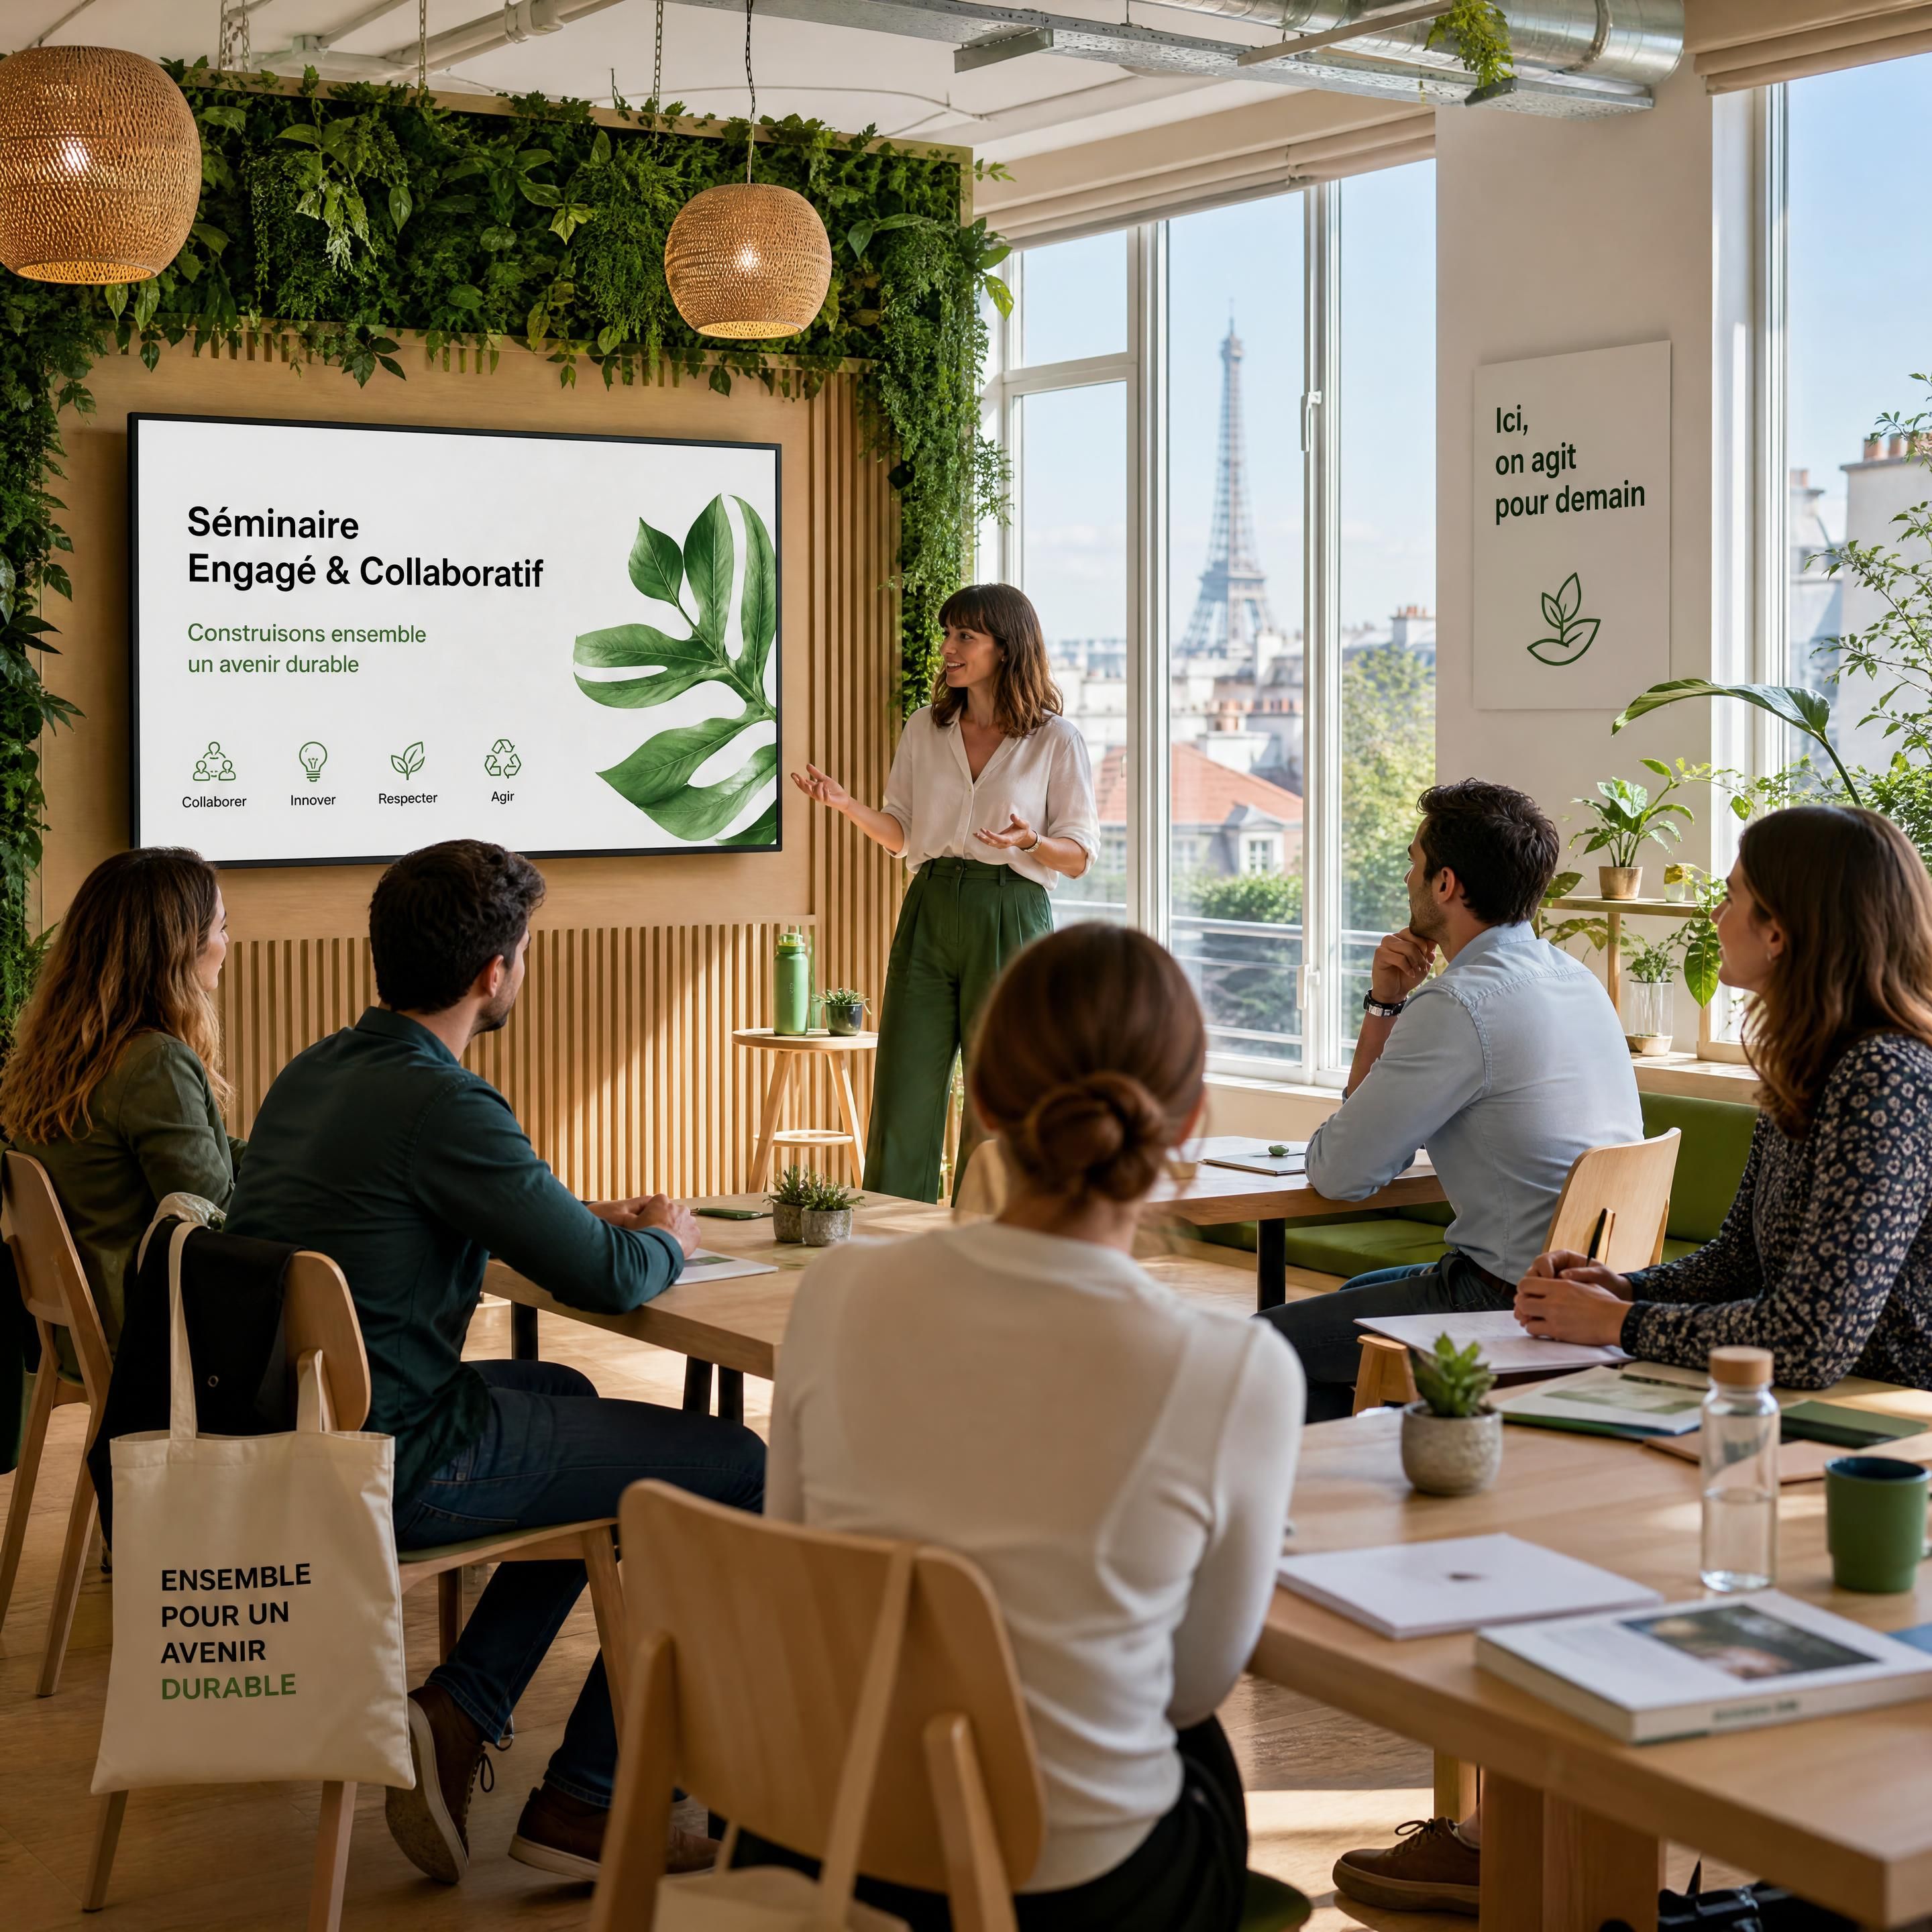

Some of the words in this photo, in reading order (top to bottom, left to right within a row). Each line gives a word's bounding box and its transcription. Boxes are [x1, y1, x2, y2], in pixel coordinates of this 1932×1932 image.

[1496, 404, 1528, 436] Ici,
[1495, 453, 1524, 476] on
[1532, 442, 1577, 478] agit
[1495, 494, 1549, 526] pour
[1555, 479, 1646, 513] demain
[187, 505, 360, 541] Séminaire
[189, 553, 317, 592] Engagé
[326, 555, 351, 586] &
[360, 556, 544, 588] Collaboratif
[187, 622, 326, 643] Construisons
[331, 625, 427, 644] ensemble
[188, 658, 213, 674] un
[219, 654, 281, 674] avenir
[285, 654, 360, 674] durable
[182, 794, 248, 808] Collaborer
[290, 794, 337, 806] Innover
[378, 792, 438, 808] Respecter
[490, 790, 515, 806] Agir
[161, 1563, 312, 1592] ENSEMBLE
[161, 1604, 239, 1627] POUR
[249, 1601, 290, 1625] UN
[160, 1639, 267, 1664] AVENIR
[161, 1673, 297, 1701] DURABLE
